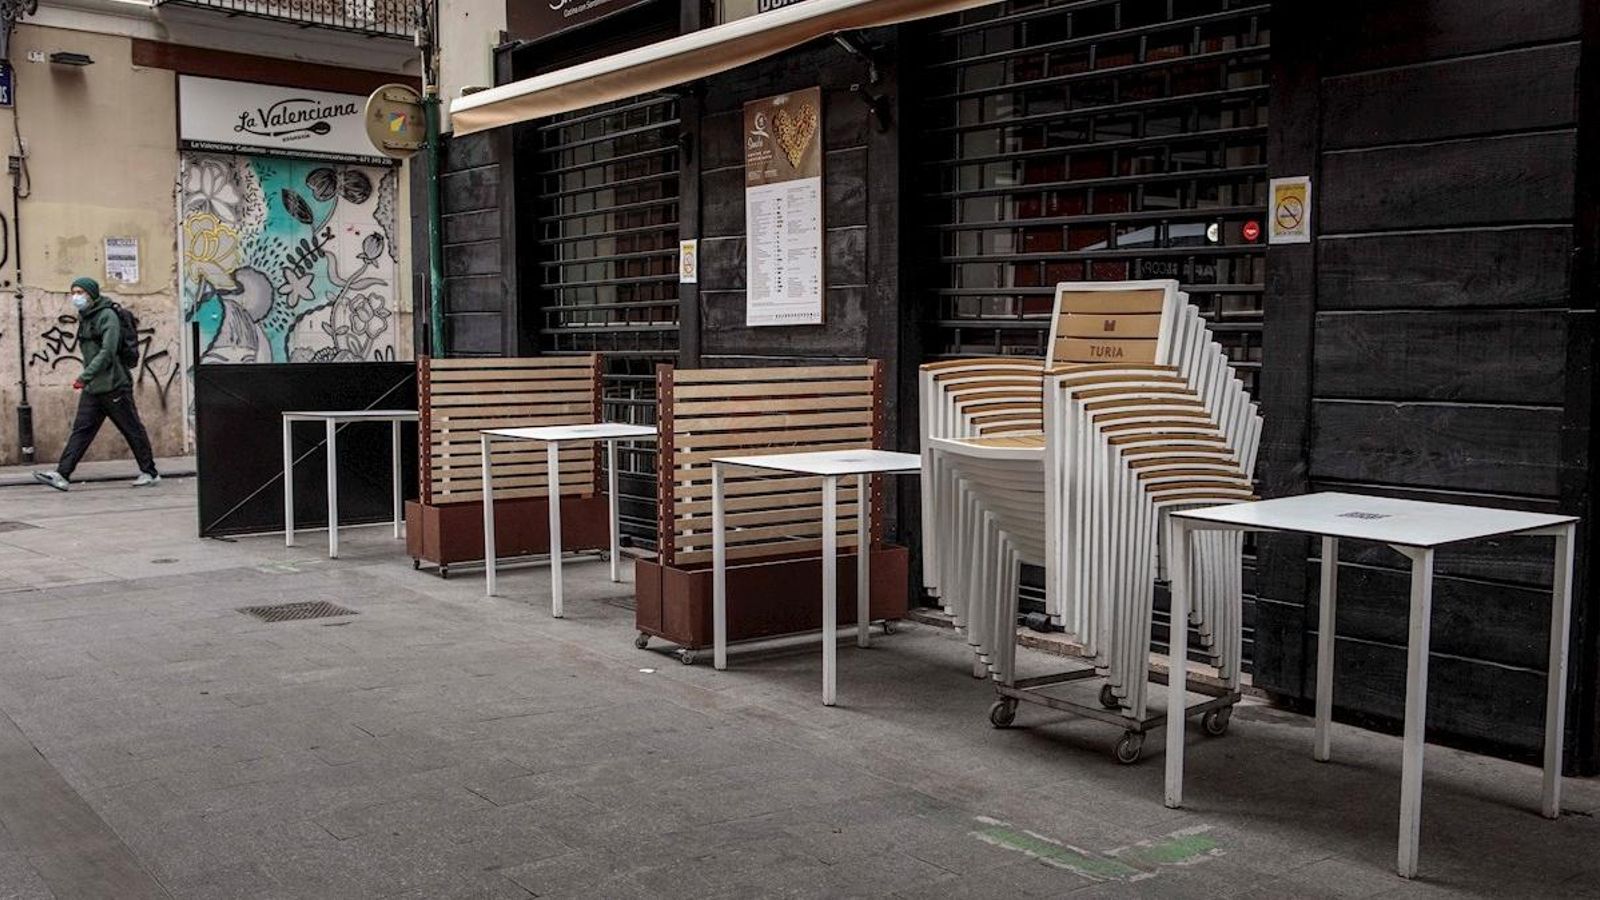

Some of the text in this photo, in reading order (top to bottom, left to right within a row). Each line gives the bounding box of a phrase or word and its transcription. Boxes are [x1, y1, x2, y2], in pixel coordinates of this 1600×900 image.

[0, 86, 8, 103] S
[234, 99, 358, 132] La Valenciana
[200, 142, 233, 152] Valenciana
[1090, 345, 1123, 358] TURIA
